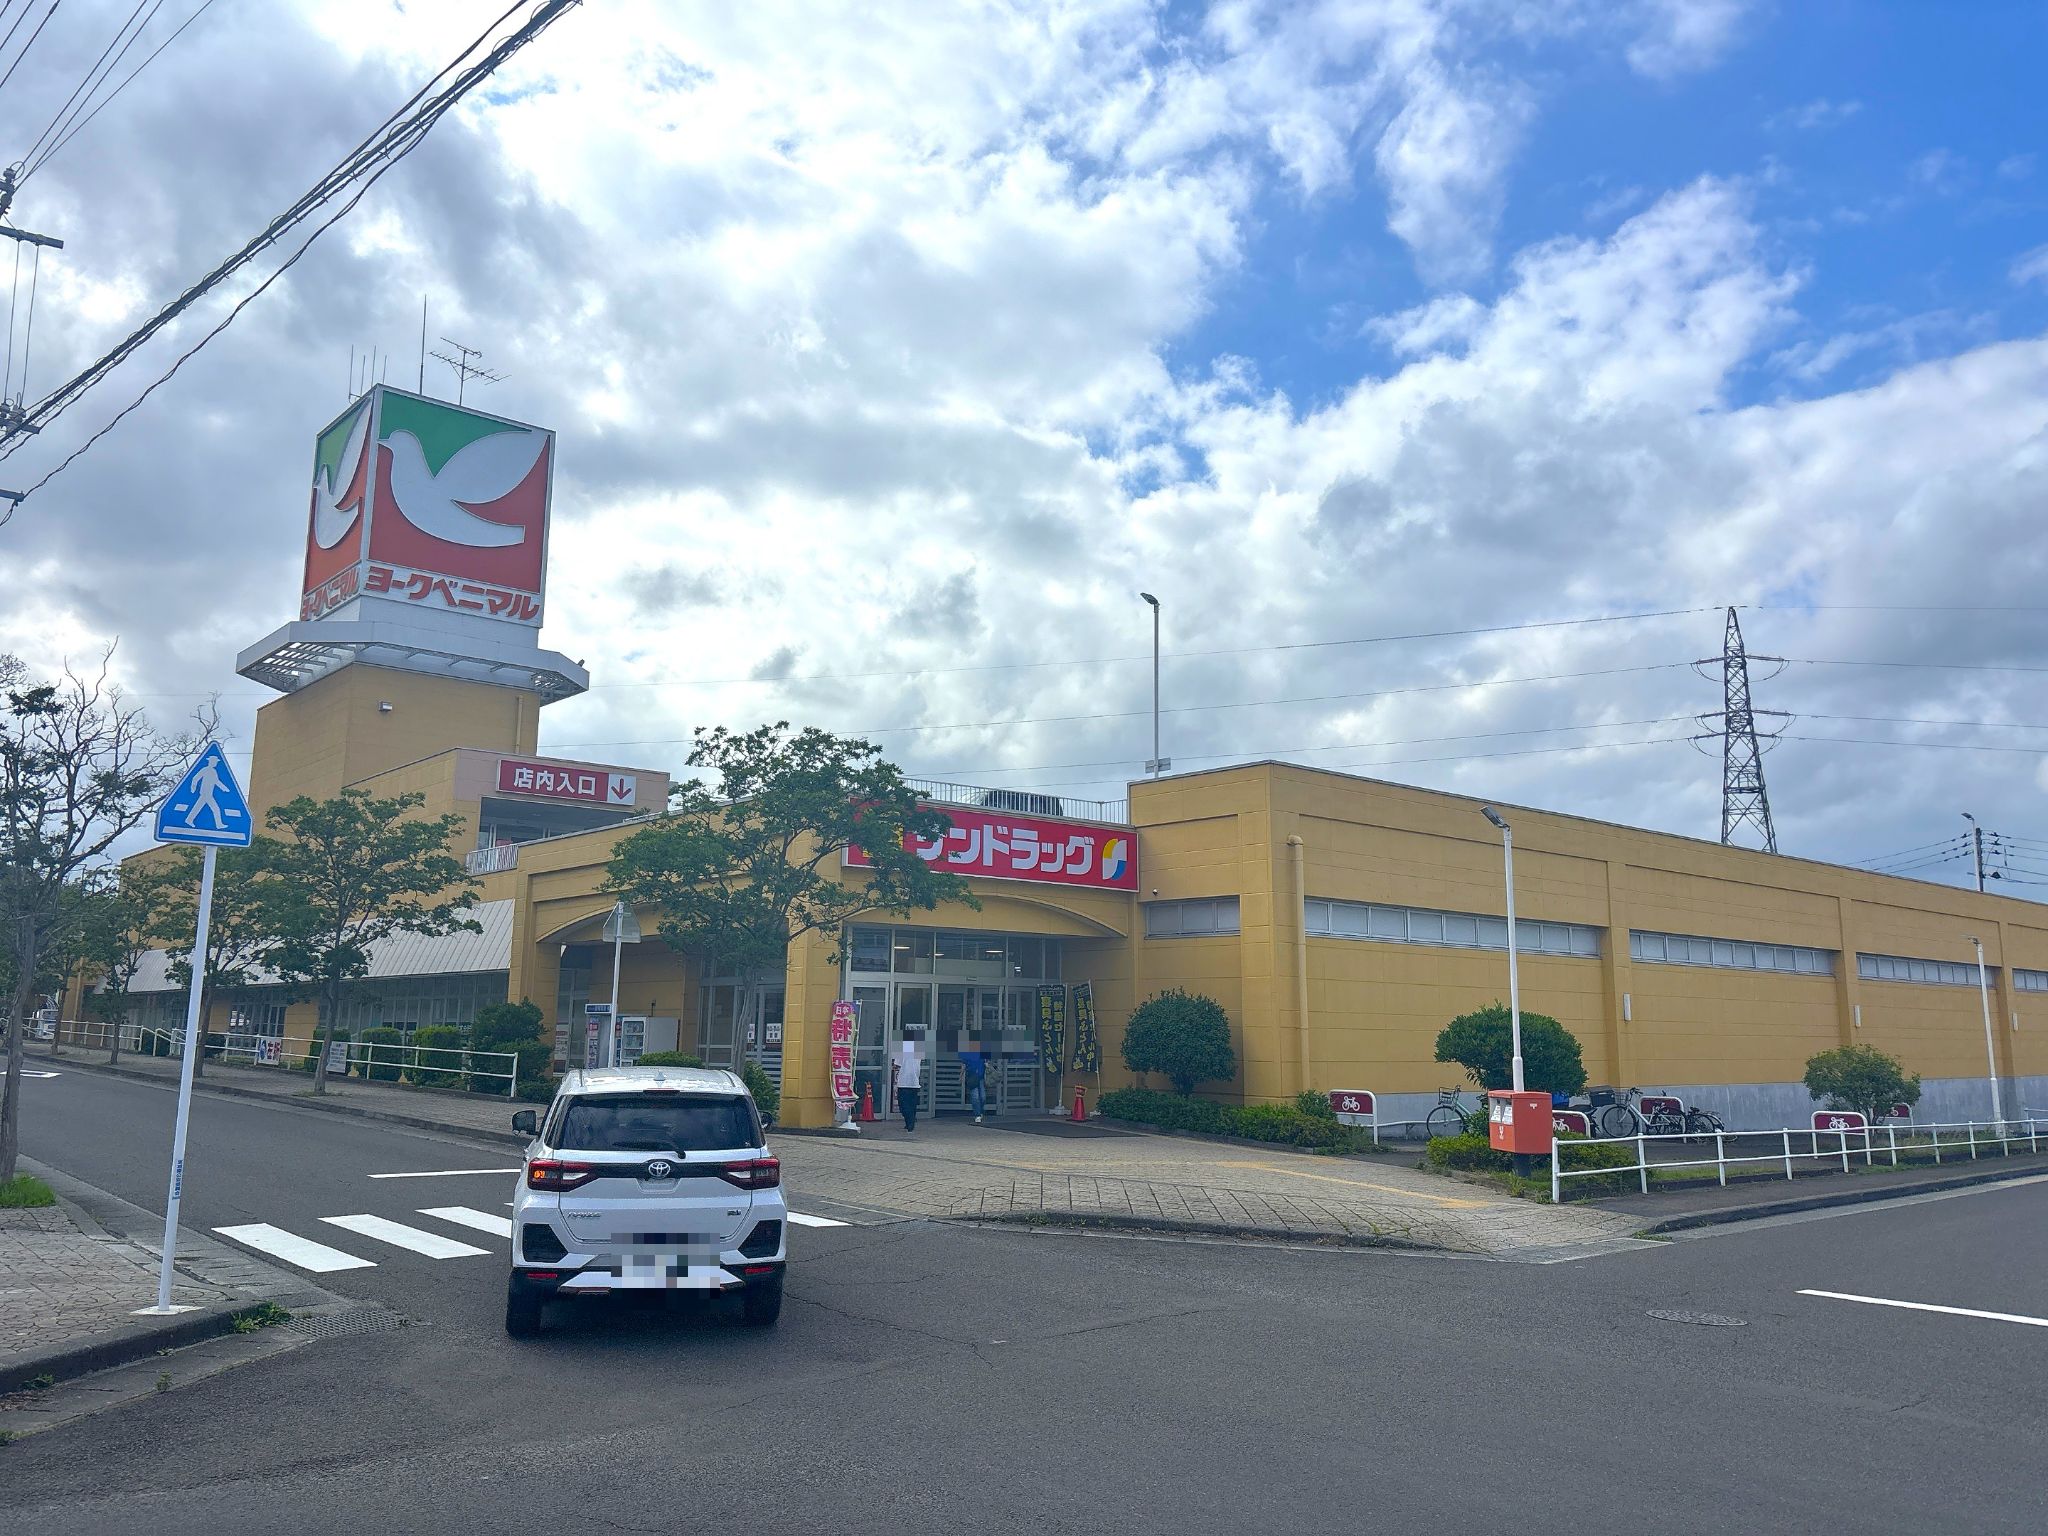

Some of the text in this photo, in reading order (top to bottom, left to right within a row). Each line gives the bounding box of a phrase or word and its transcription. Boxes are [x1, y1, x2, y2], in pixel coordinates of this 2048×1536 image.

[363, 565, 541, 621] ヨークベニマル
[513, 767, 596, 796] 店内入口
